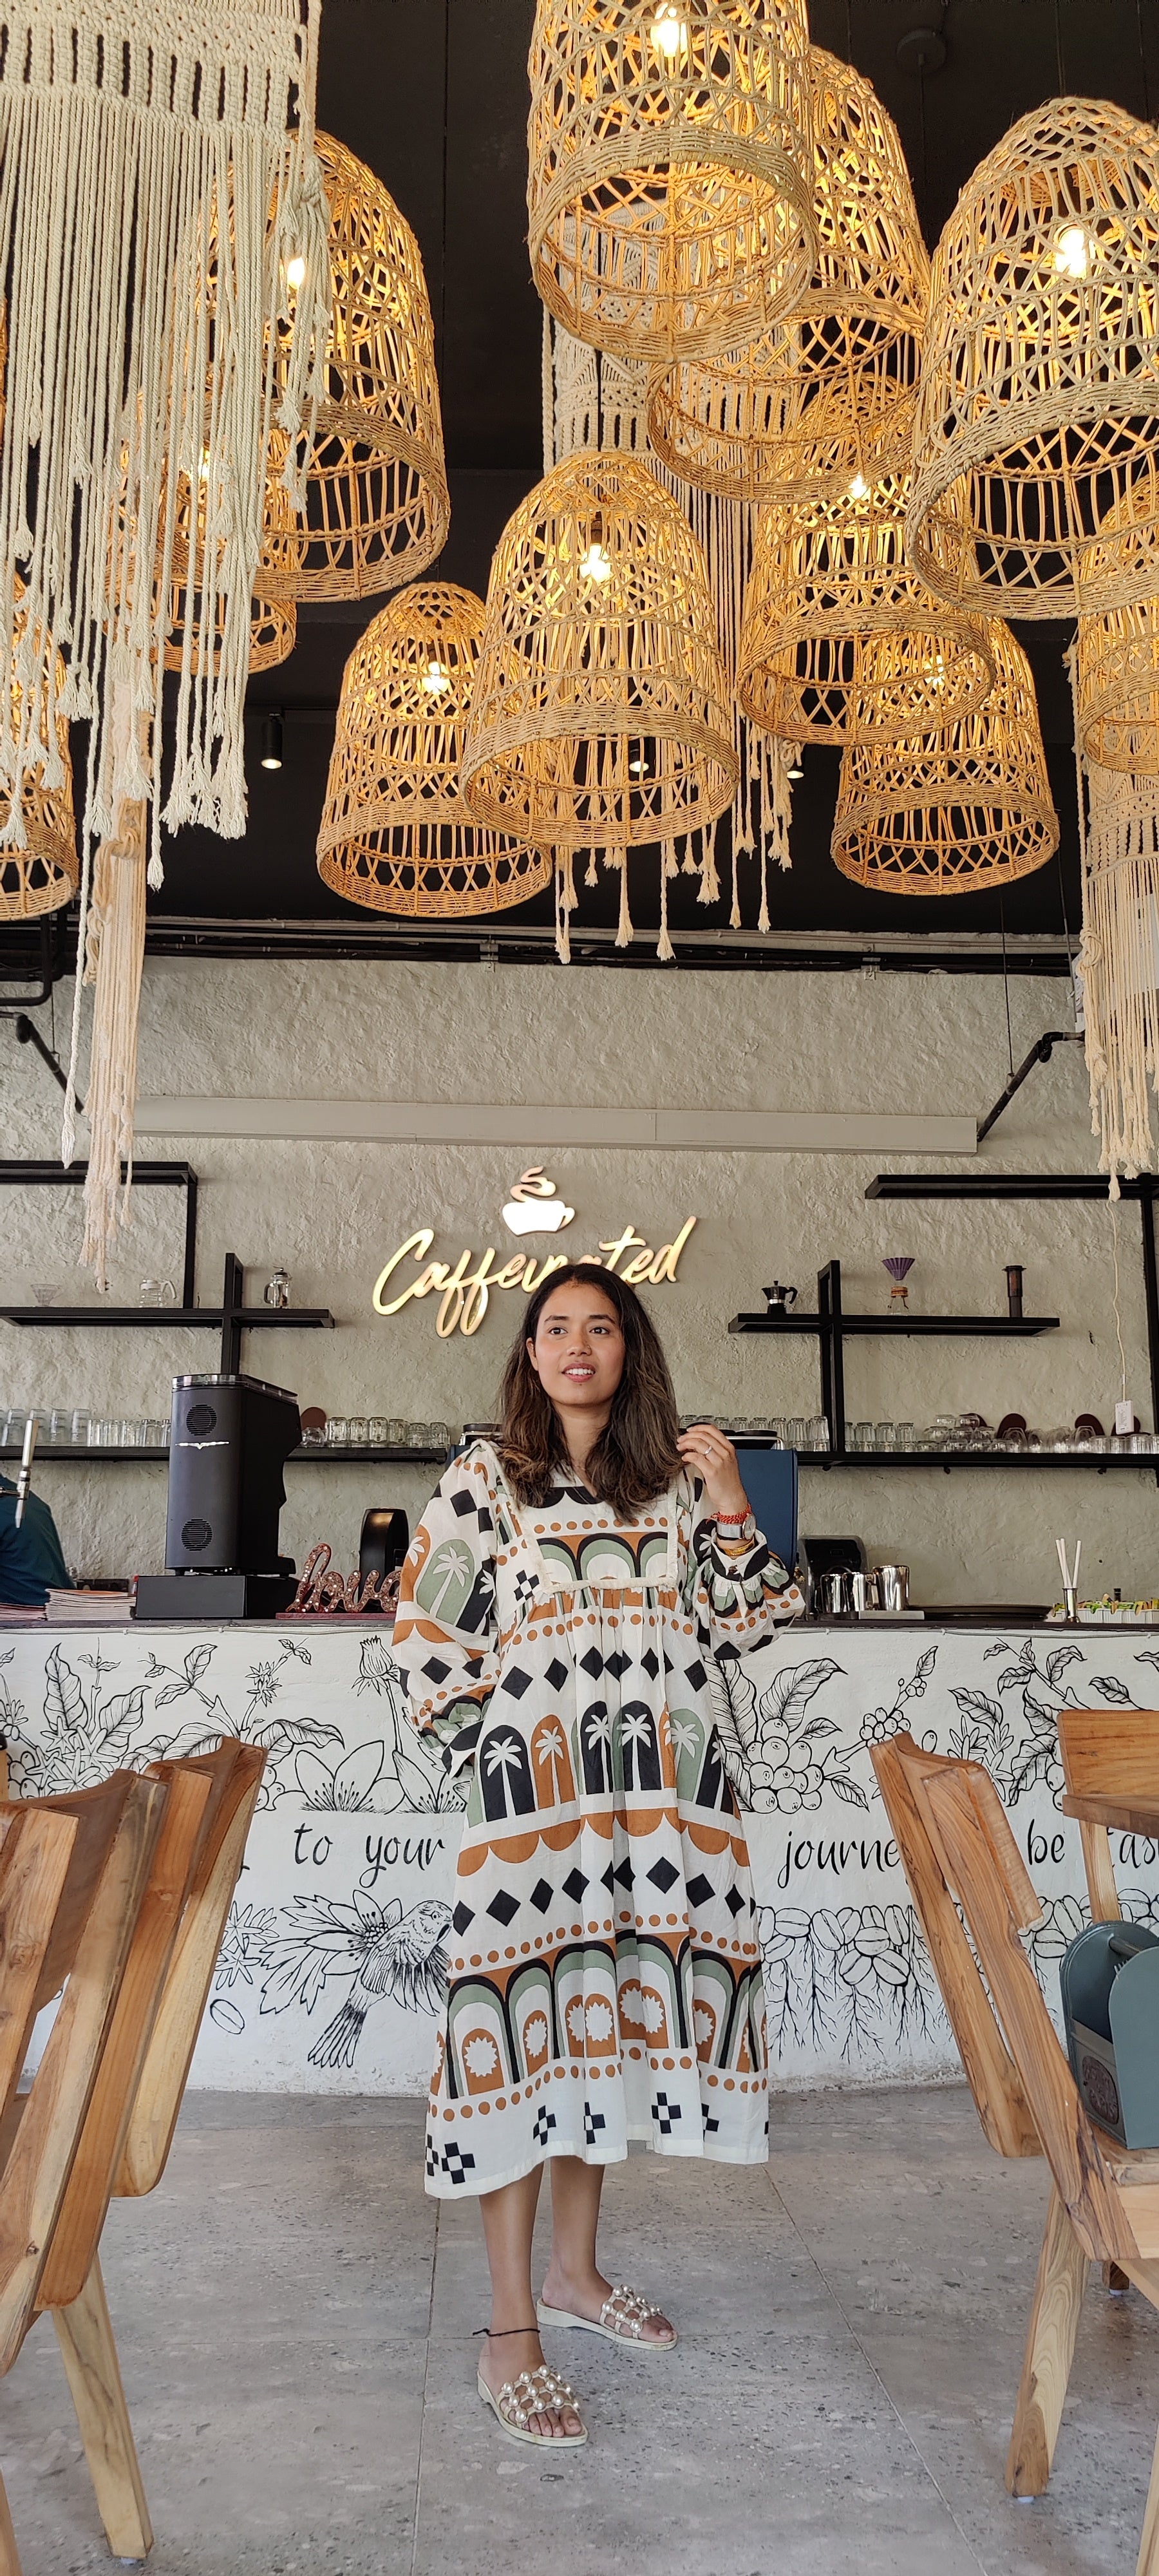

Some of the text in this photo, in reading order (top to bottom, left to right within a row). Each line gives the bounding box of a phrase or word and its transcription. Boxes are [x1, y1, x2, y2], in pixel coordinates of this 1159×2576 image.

[294, 1823, 334, 1865] to
[359, 1835, 446, 1888] your
[777, 1830, 909, 1889] journe
[1027, 1819, 1065, 1866] be
